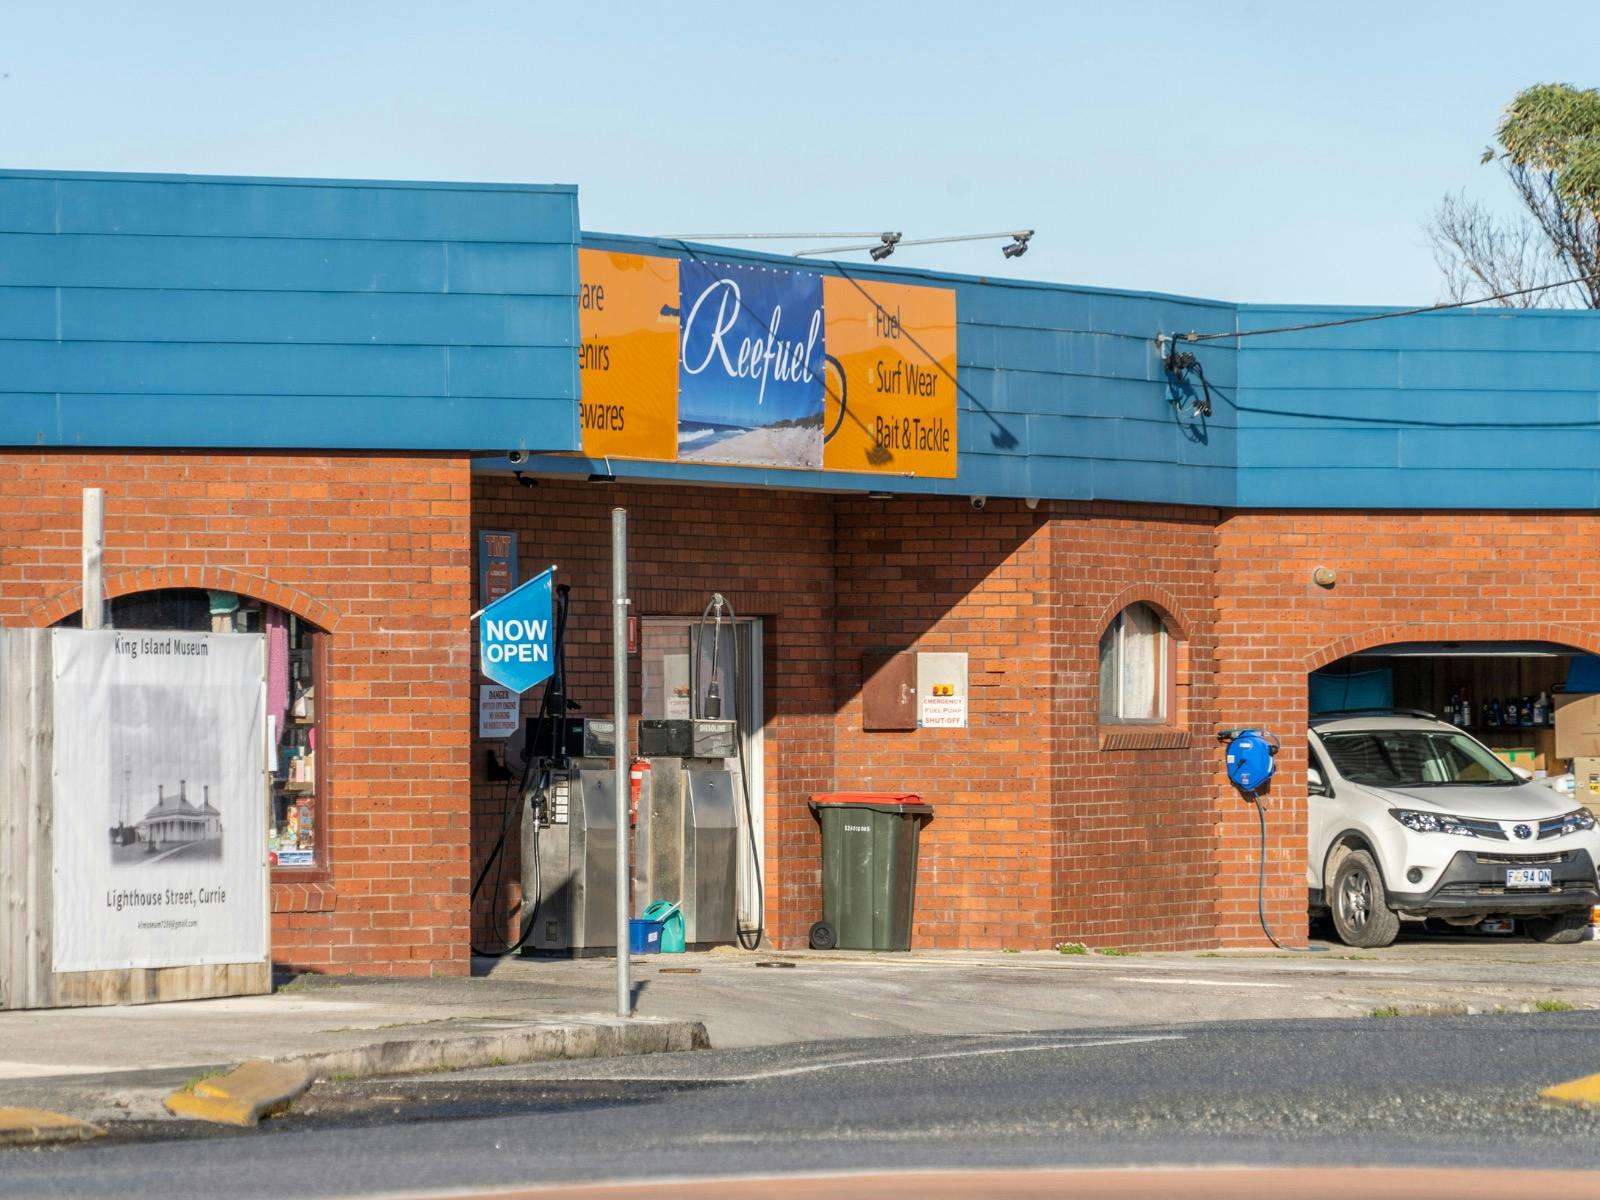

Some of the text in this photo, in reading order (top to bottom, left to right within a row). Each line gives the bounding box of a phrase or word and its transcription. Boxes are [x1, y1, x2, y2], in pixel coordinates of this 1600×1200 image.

[876, 305, 900, 339] Fuel
[682, 278, 821, 405] Reefuel
[877, 360, 938, 397] Surf Wear
[876, 415, 950, 452] Bait & Tackle
[487, 619, 548, 641] NOW
[115, 637, 208, 659] King Island Museum
[487, 643, 548, 663] OPEN
[1523, 870, 1535, 882] 94
[106, 886, 226, 912] Lighthouse Street, Currie
